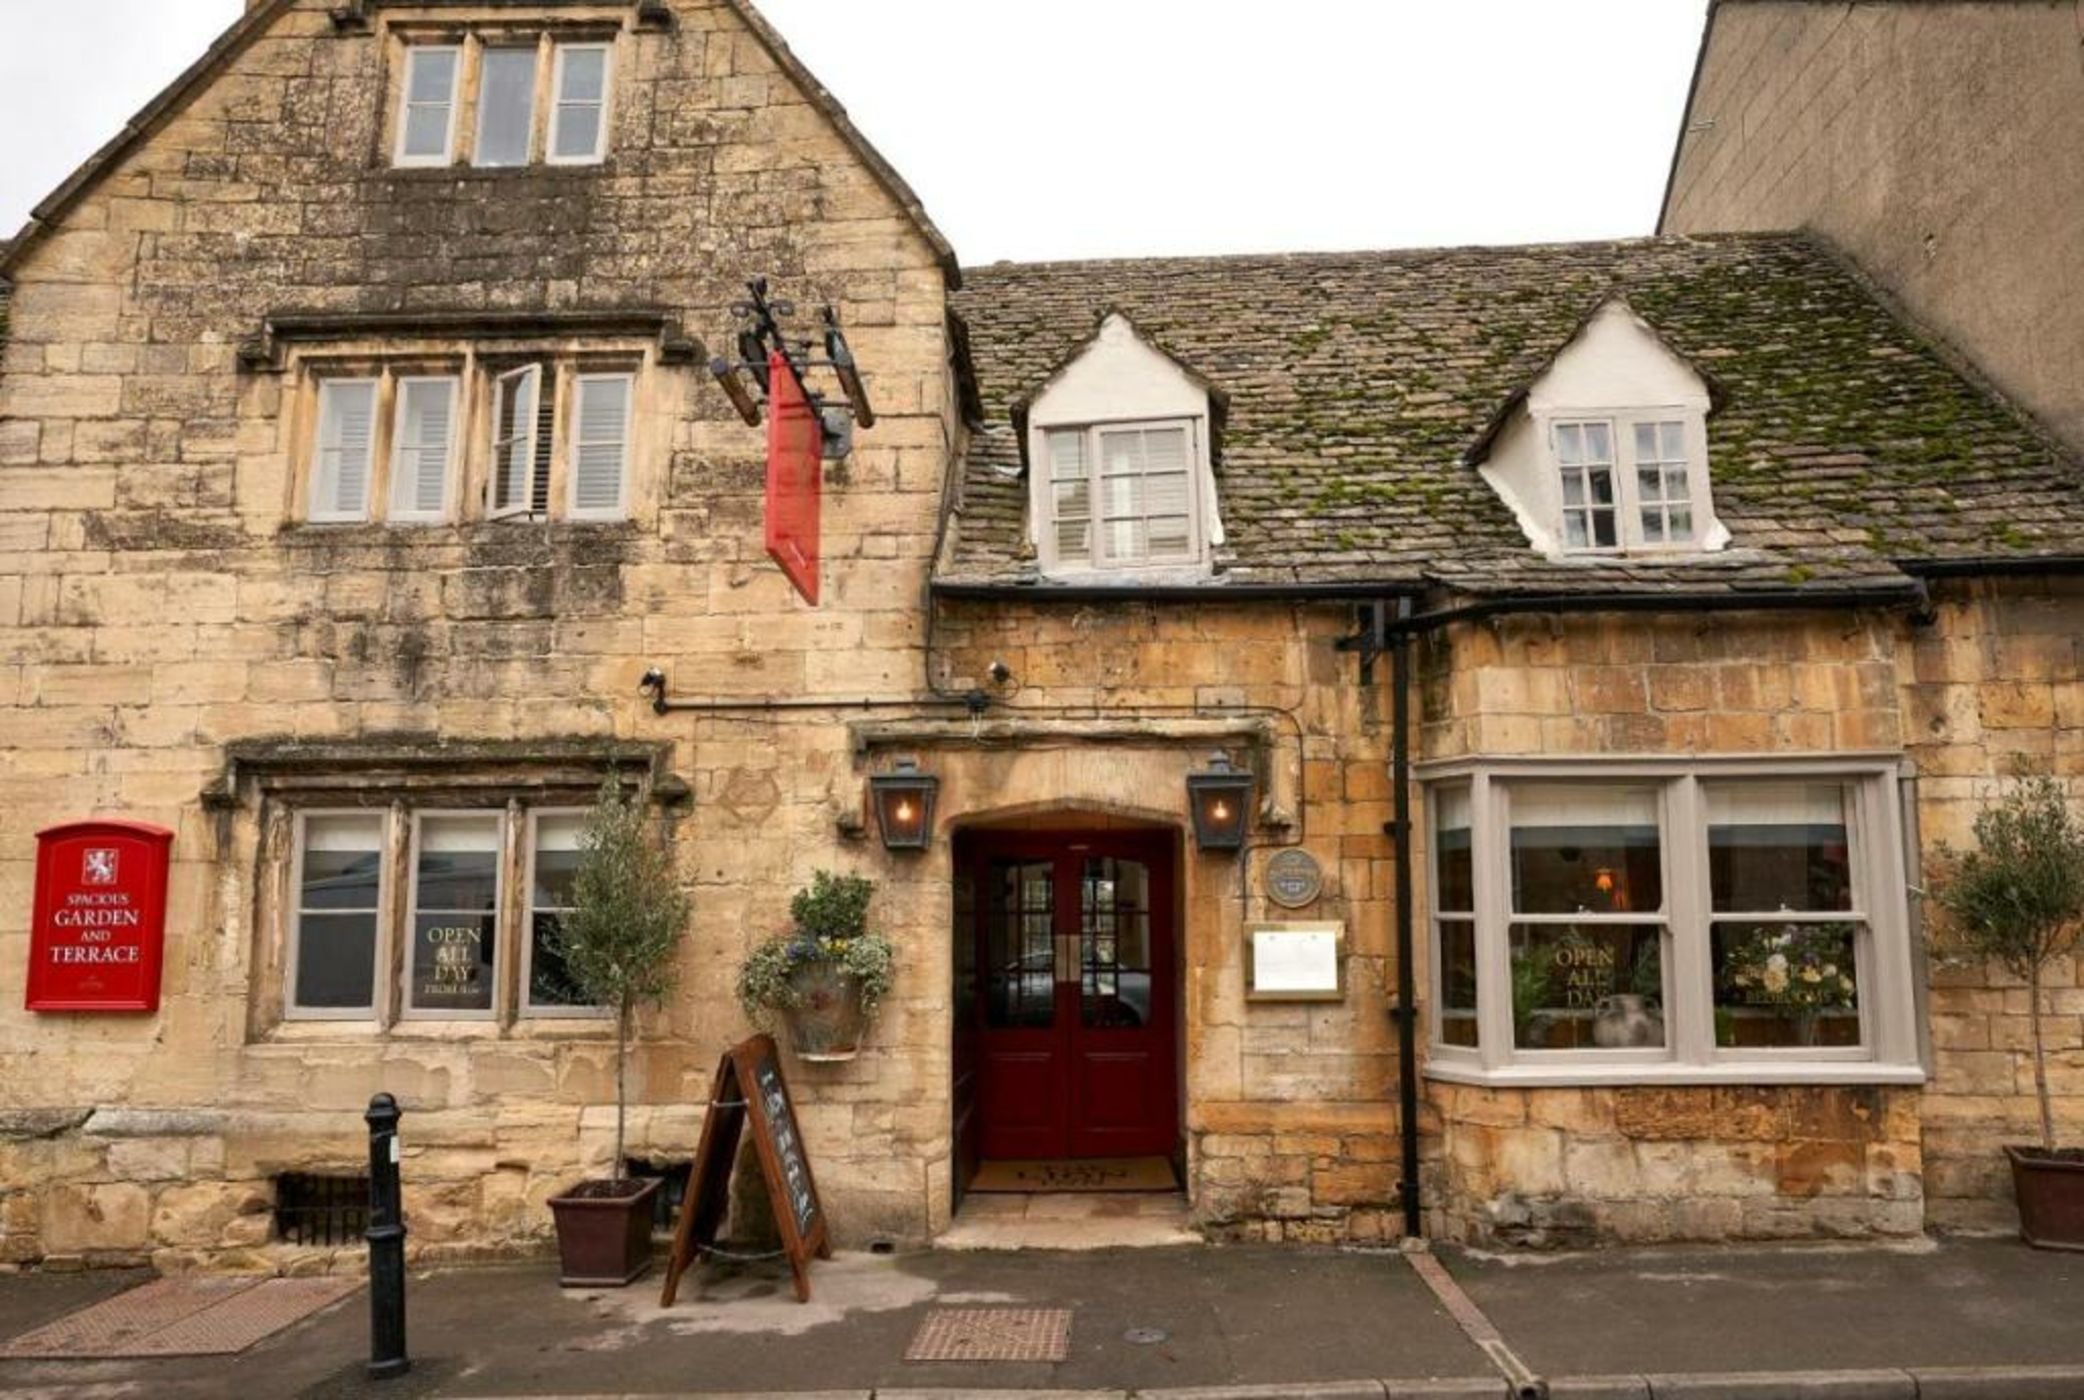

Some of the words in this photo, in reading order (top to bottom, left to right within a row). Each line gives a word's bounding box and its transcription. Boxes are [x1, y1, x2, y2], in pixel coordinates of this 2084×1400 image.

[66, 892, 130, 906] SPACIOUS
[54, 908, 139, 926] GARDEN
[81, 930, 111, 942] AND
[428, 926, 482, 943] OPEN
[50, 946, 139, 964] TERRACE
[437, 945, 472, 962] ALL
[1555, 947, 1614, 967] OPEN
[434, 965, 471, 980] DAY
[1567, 968, 1608, 986] ALL
